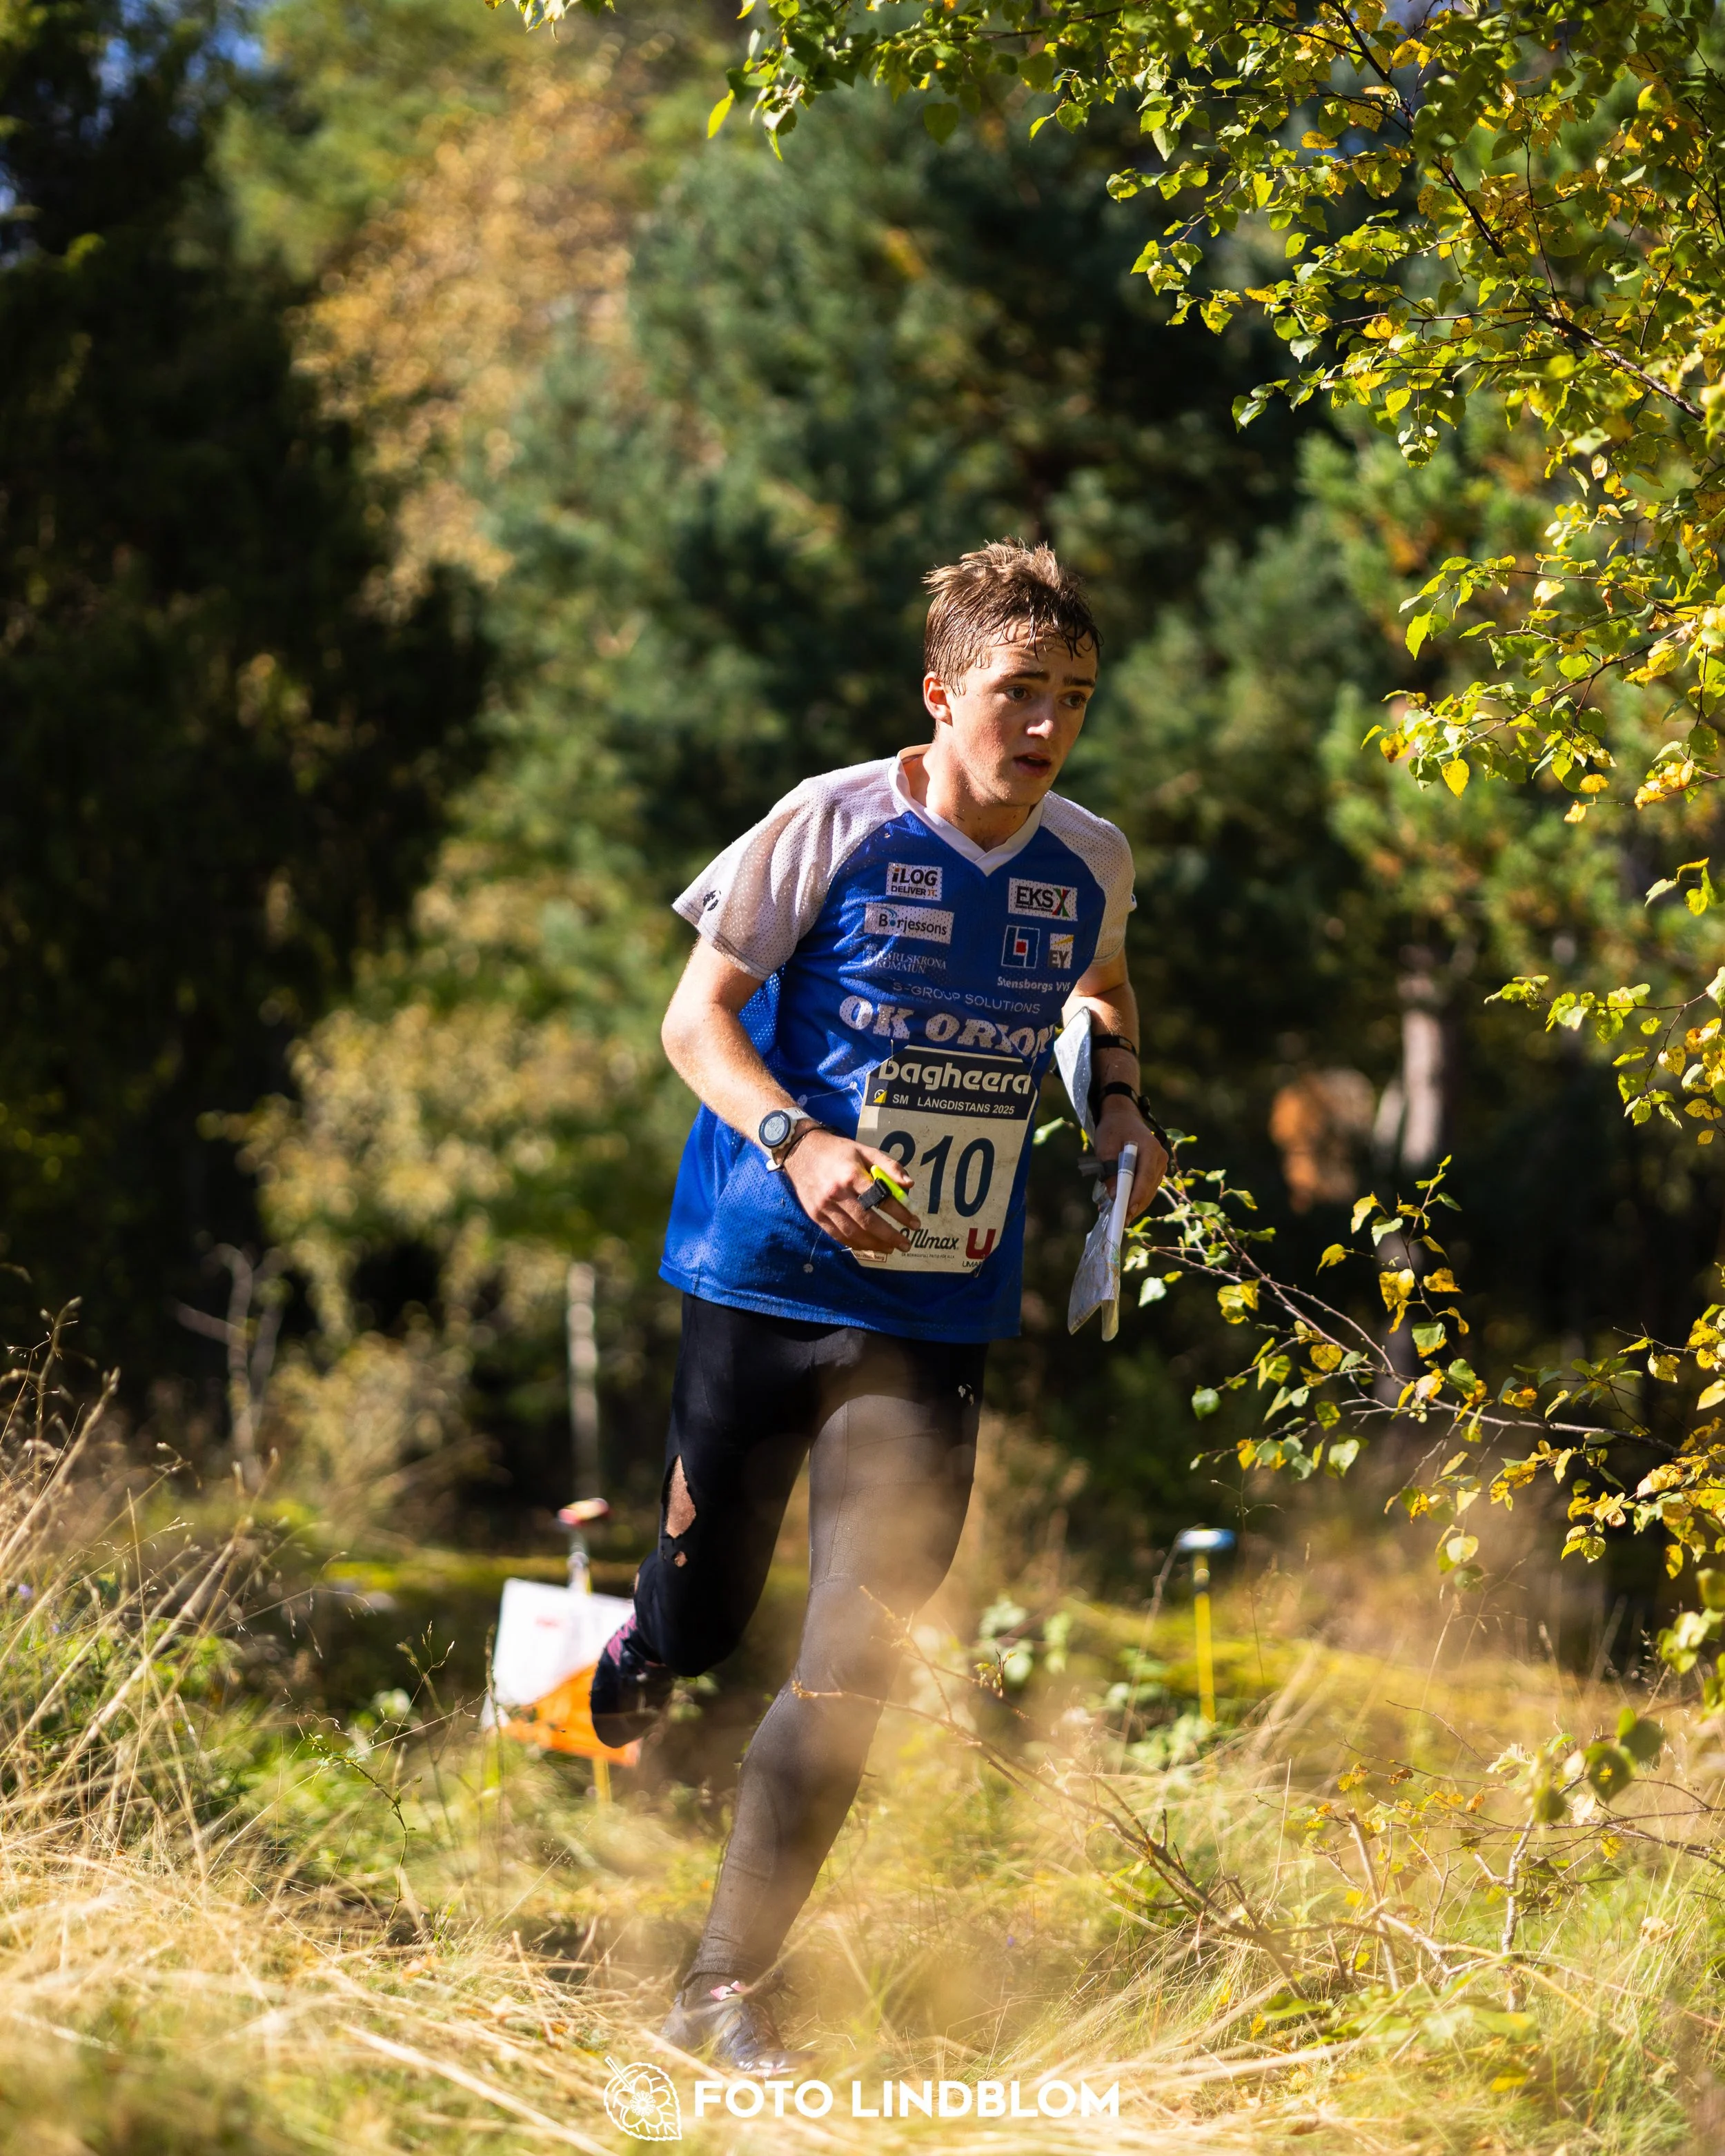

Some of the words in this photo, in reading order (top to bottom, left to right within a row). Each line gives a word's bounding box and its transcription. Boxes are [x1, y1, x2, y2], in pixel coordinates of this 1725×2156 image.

[891, 867, 938, 887] iLOG
[891, 885, 927, 896] DELIVER
[1049, 950, 1070, 969] EY
[965, 993, 1041, 1014] SOLUTIONS
[839, 995, 914, 1040] OK
[892, 1094, 909, 1105] SM
[917, 1096, 990, 1113] LÅNGDISTANS
[992, 1105, 1015, 1115] 2025
